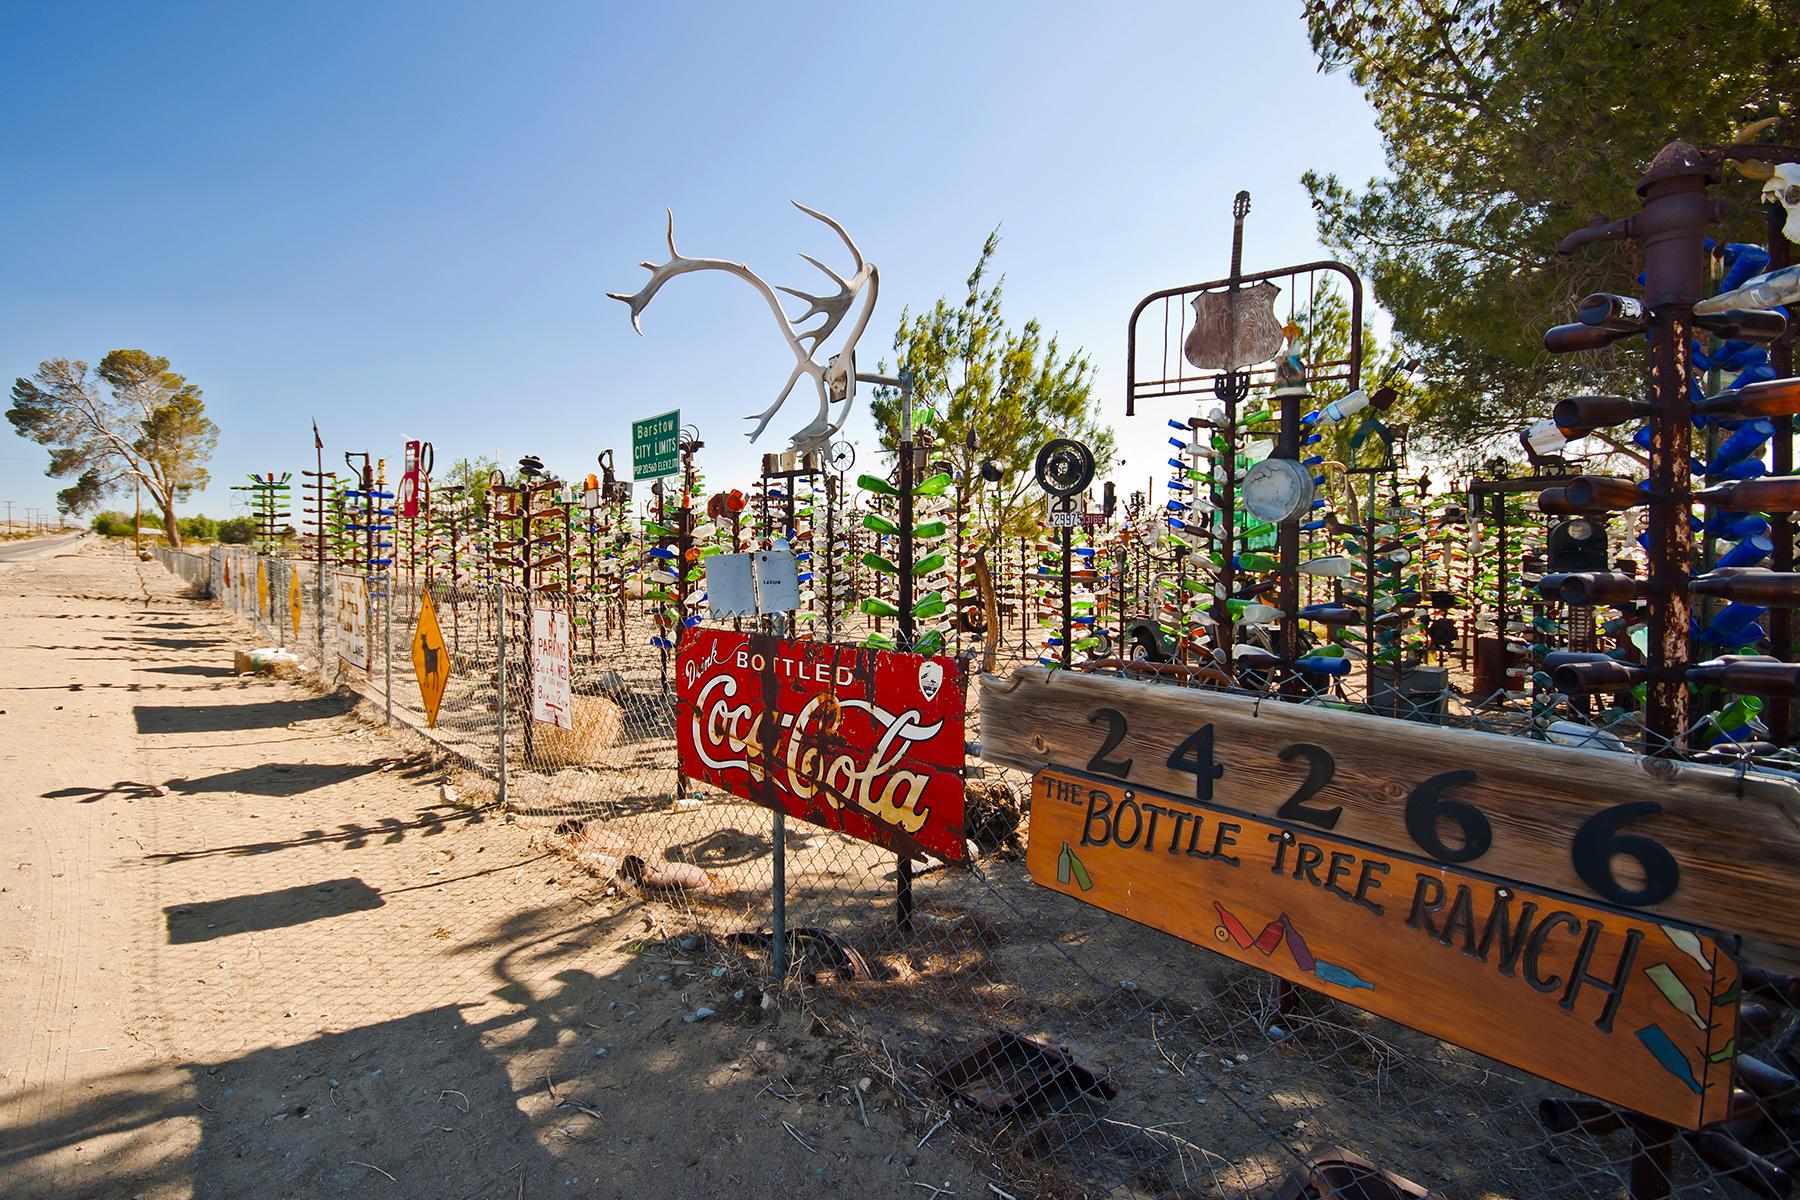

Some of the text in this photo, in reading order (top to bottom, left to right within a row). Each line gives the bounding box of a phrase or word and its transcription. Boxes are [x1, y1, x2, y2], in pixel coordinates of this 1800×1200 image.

[634, 437, 677, 460] CITY LIMITS
[637, 420, 674, 439] Barstow
[684, 638, 737, 690] Drink
[691, 674, 943, 834] Coca-Cola
[1087, 707, 1680, 907] 24266
[1042, 776, 1645, 1034] THE BOTTLE TREE RANCH
